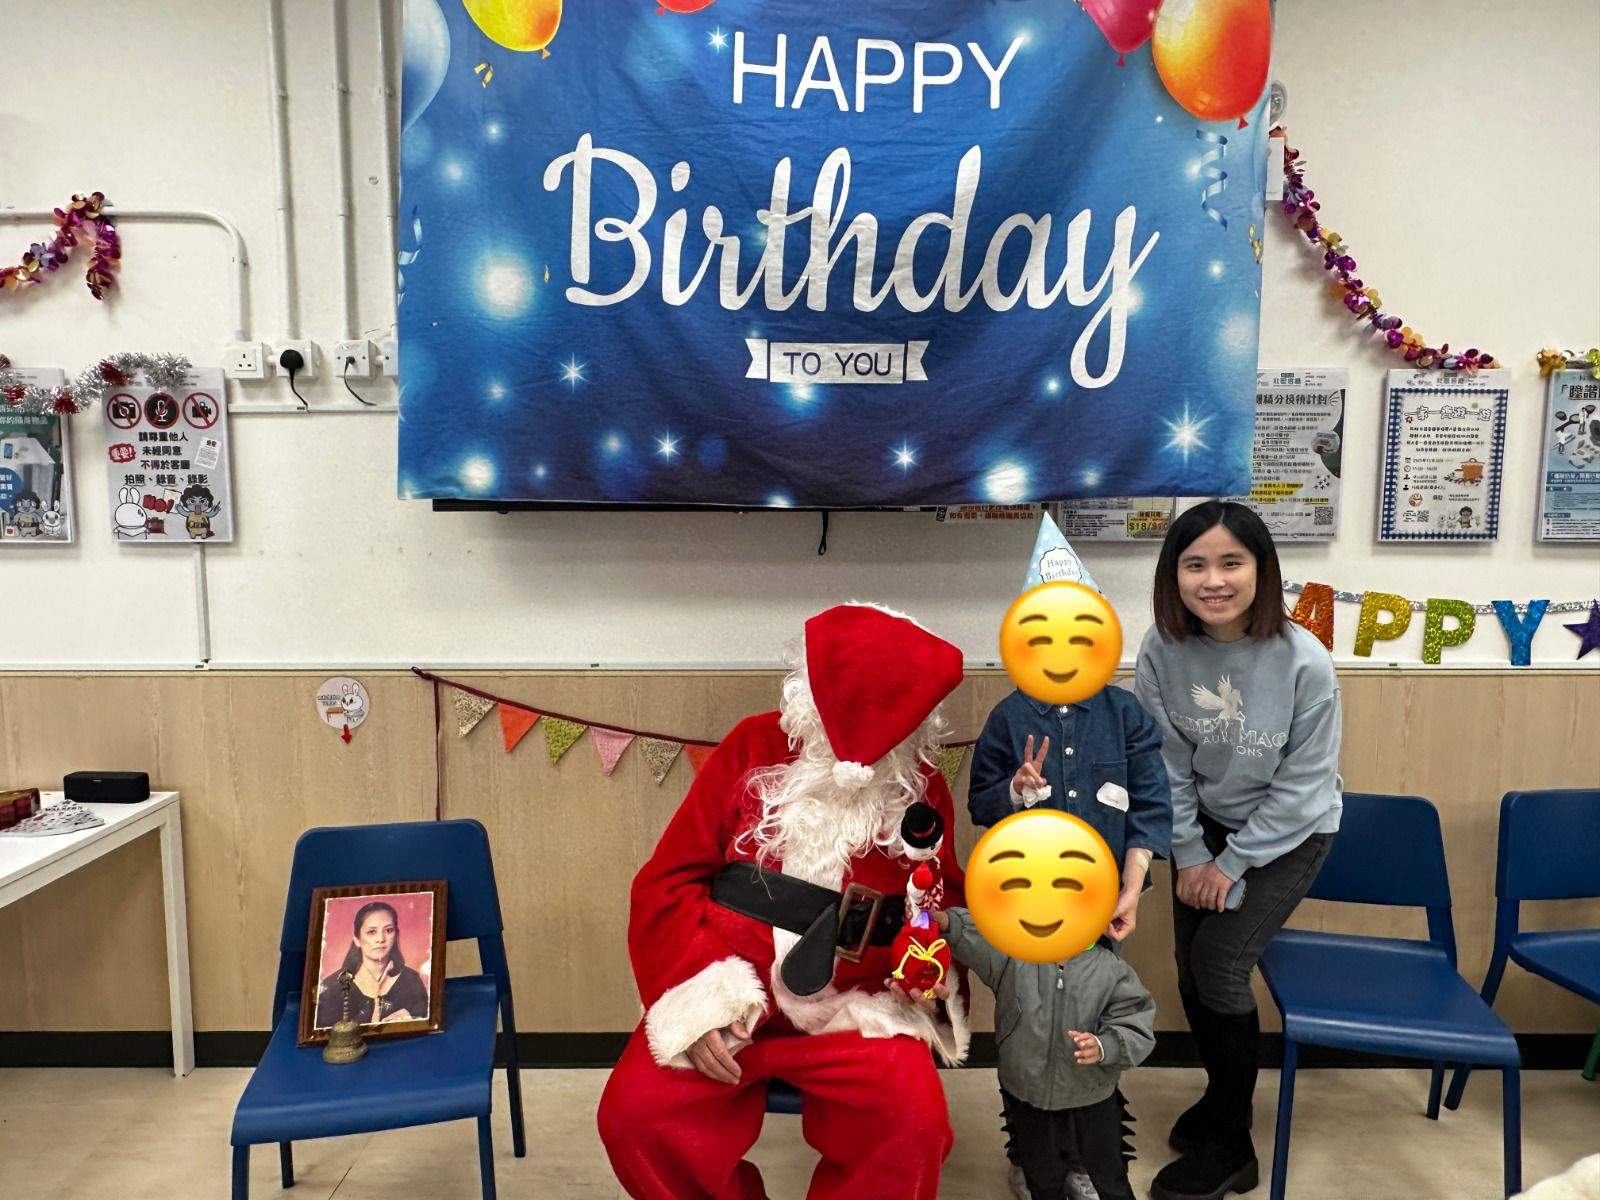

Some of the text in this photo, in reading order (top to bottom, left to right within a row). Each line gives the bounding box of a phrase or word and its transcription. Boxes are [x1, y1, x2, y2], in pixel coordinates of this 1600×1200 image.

[732, 31, 1025, 114] HAPPY
[543, 132, 1160, 389] Birthday
[783, 352, 892, 376] TO YOU
[142, 445, 183, 456] 未經同意
[1047, 559, 1072, 568] Happy
